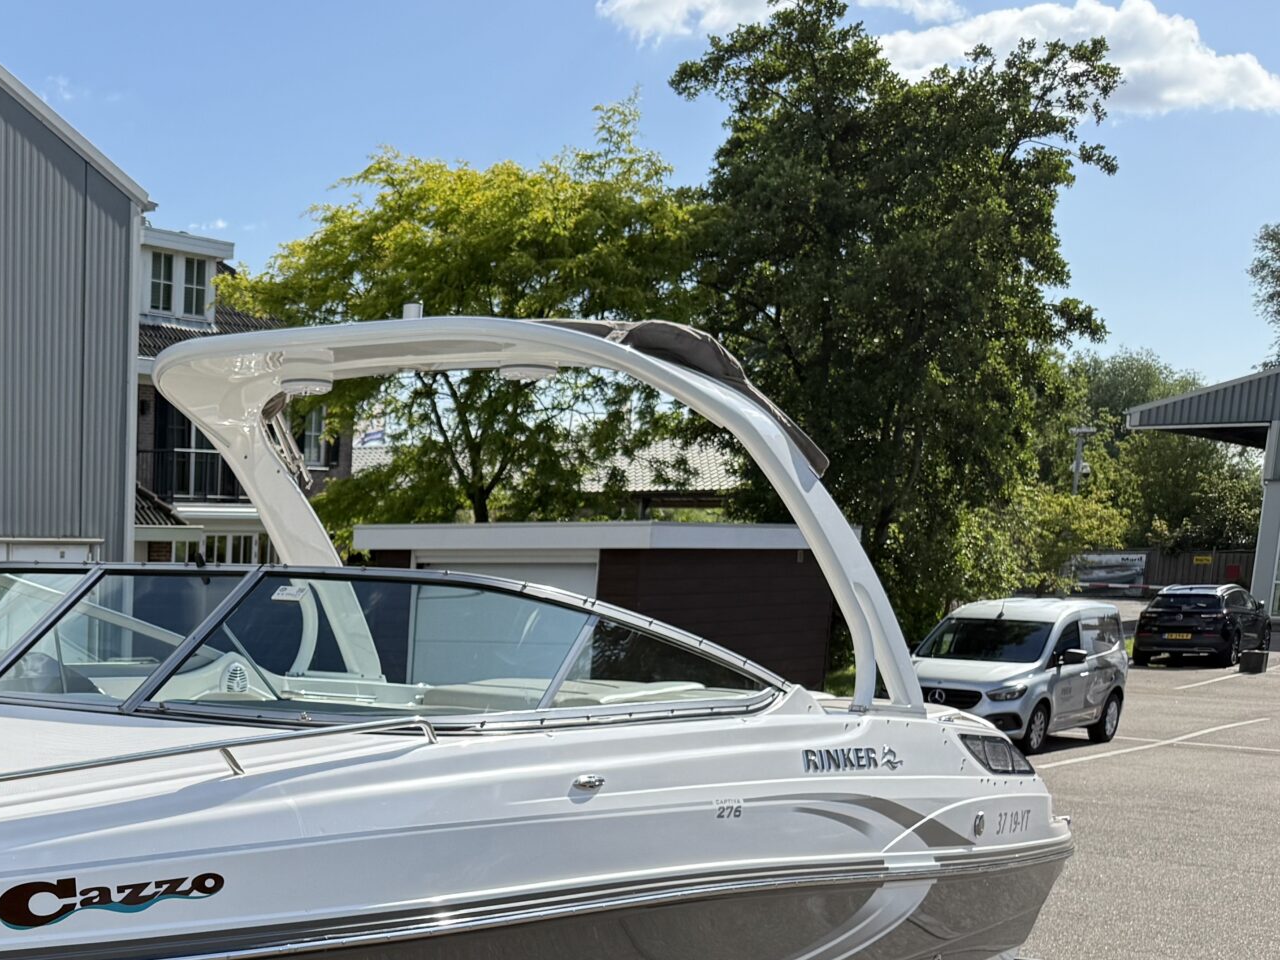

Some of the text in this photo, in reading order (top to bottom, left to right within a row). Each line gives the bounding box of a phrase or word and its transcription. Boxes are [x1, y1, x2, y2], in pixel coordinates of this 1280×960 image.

[802, 747, 879, 773] RINKER
[716, 805, 742, 819] 276
[996, 812, 1008, 835] 37
